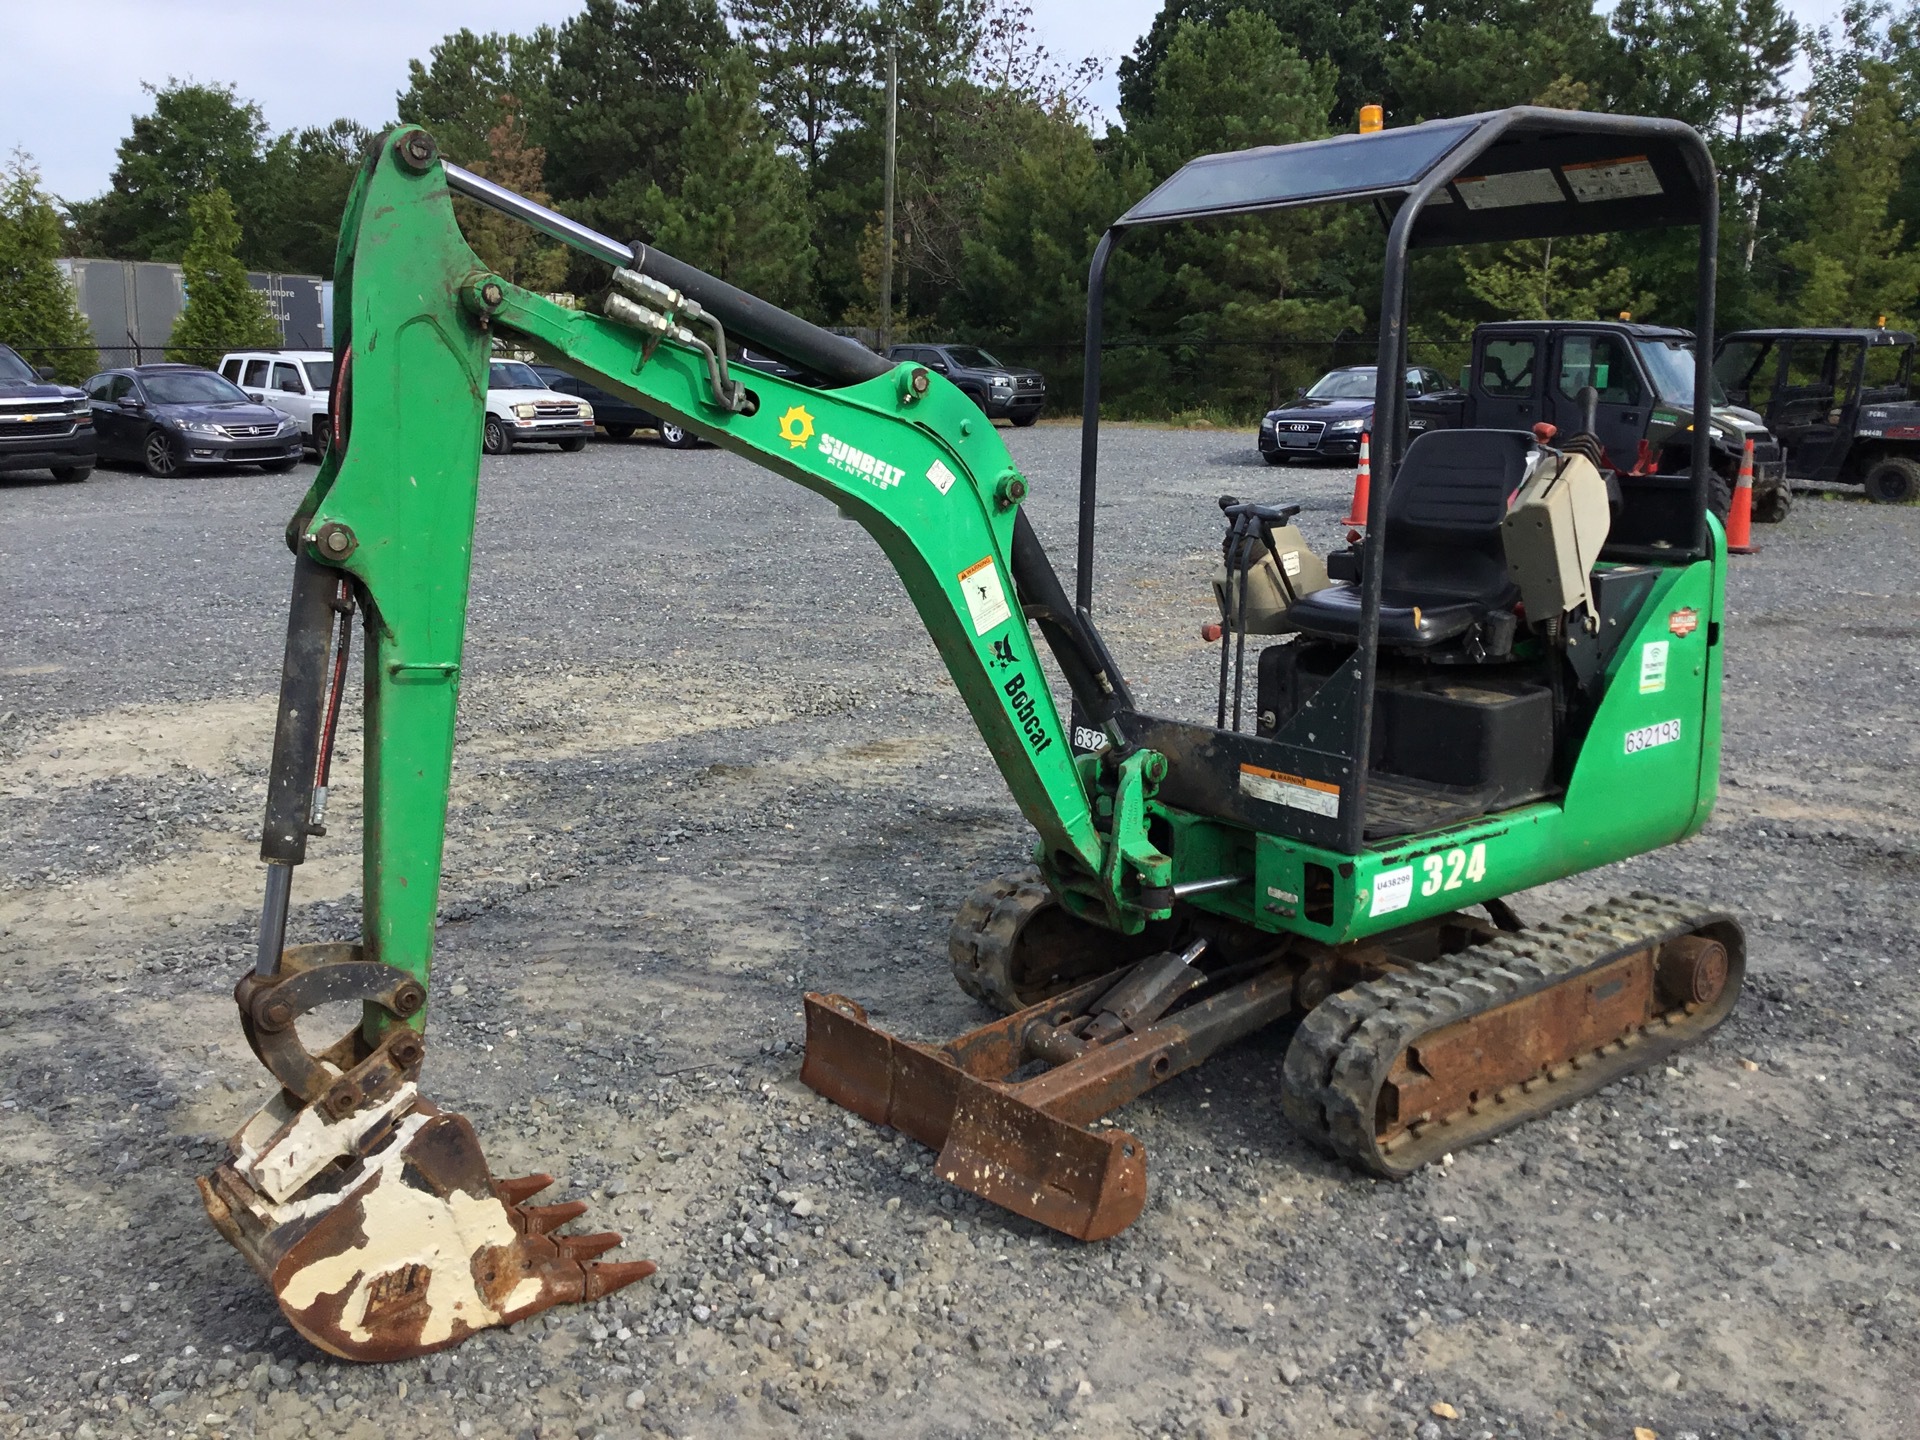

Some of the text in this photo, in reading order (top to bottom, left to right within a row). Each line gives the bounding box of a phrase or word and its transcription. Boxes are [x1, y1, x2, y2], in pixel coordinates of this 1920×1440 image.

[272, 289, 296, 298] more
[818, 432, 907, 488] SUNBELT
[826, 456, 889, 491] RENTALS
[965, 557, 992, 575] WARNING
[1003, 671, 1053, 757] Bobcat
[1625, 719, 1680, 754] 632193
[1277, 773, 1307, 786] WARNING
[1376, 874, 1411, 891] U438299
[1420, 842, 1487, 897] 324
